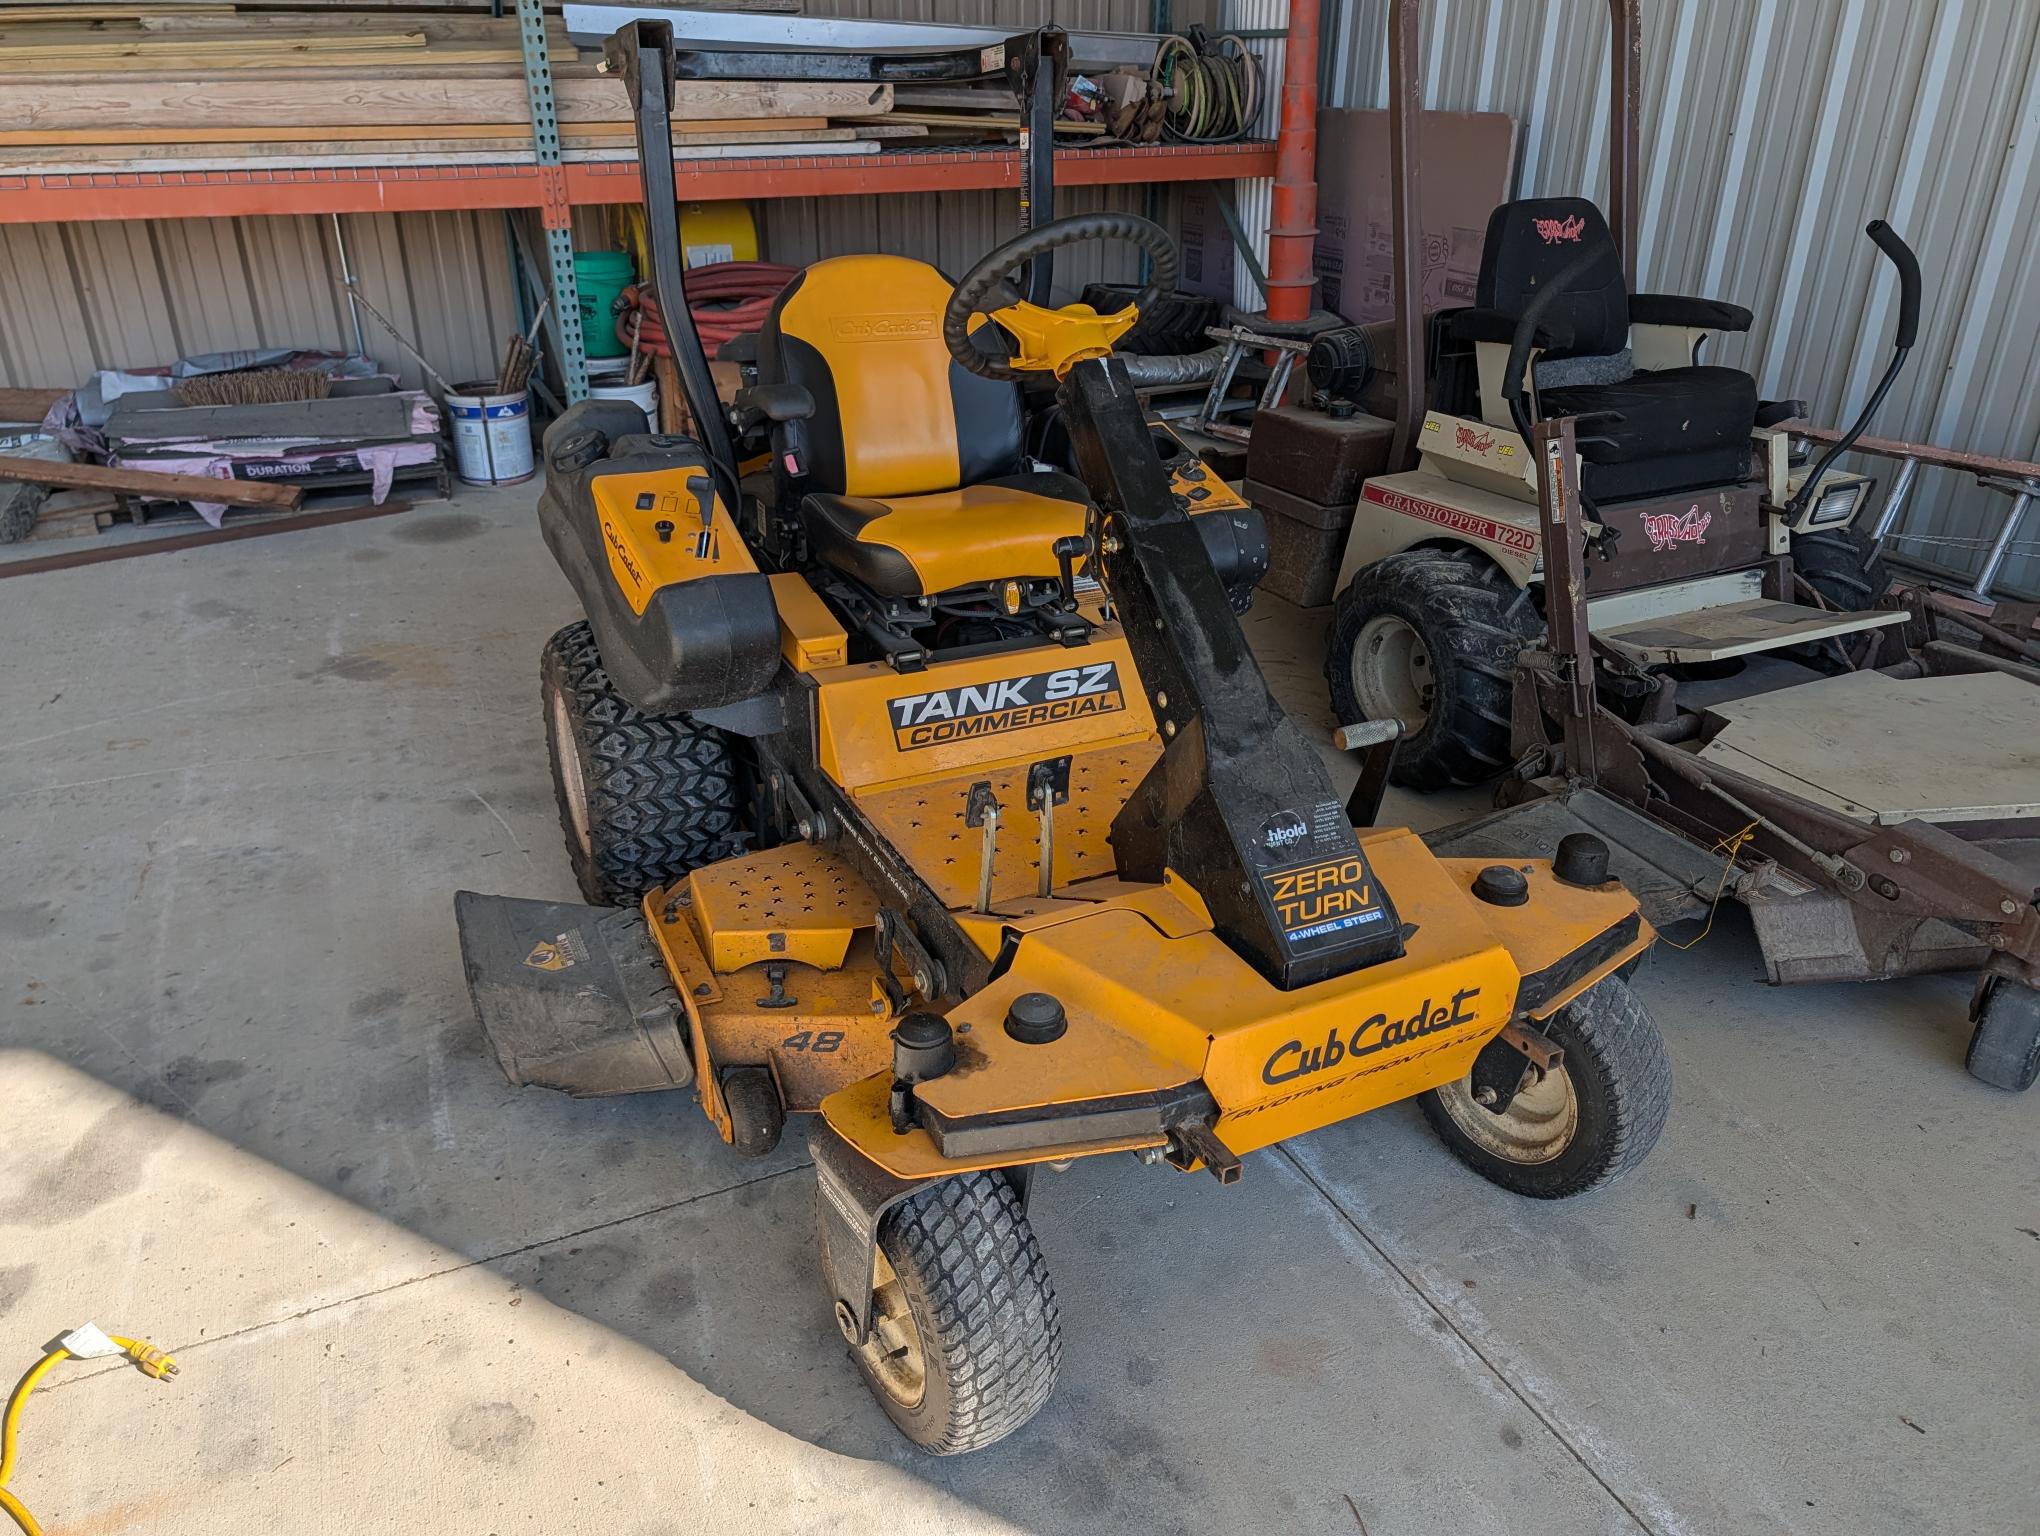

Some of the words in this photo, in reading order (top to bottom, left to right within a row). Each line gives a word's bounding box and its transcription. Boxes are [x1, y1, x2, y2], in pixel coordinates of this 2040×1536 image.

[245, 463, 312, 477] DURATION
[1382, 492, 1489, 536] GRASSHOPPER
[1498, 525, 1535, 551] 722D
[604, 521, 620, 550] Cub
[617, 543, 643, 590] Cadet
[1501, 547, 1529, 561] DIESEL
[893, 676, 1033, 727] TANK
[1044, 662, 1113, 701] SZ
[910, 694, 1114, 745] COMMERCIAL
[832, 806, 858, 839] EXTREME
[857, 836, 874, 856] DUTY
[886, 872, 910, 900] FRAME
[1267, 821, 1308, 842] hbold
[1272, 860, 1363, 902] ZERO
[1277, 884, 1369, 926] TURN
[1343, 910, 1383, 929] STEER
[781, 1030, 846, 1053] 48
[1261, 1027, 1346, 1086] Cub
[1348, 986, 1481, 1058] Cadet
[1231, 1076, 1347, 1122] PIVOTING
[1350, 1051, 1436, 1081] FRONT
[1436, 1026, 1497, 1053] AXLE
